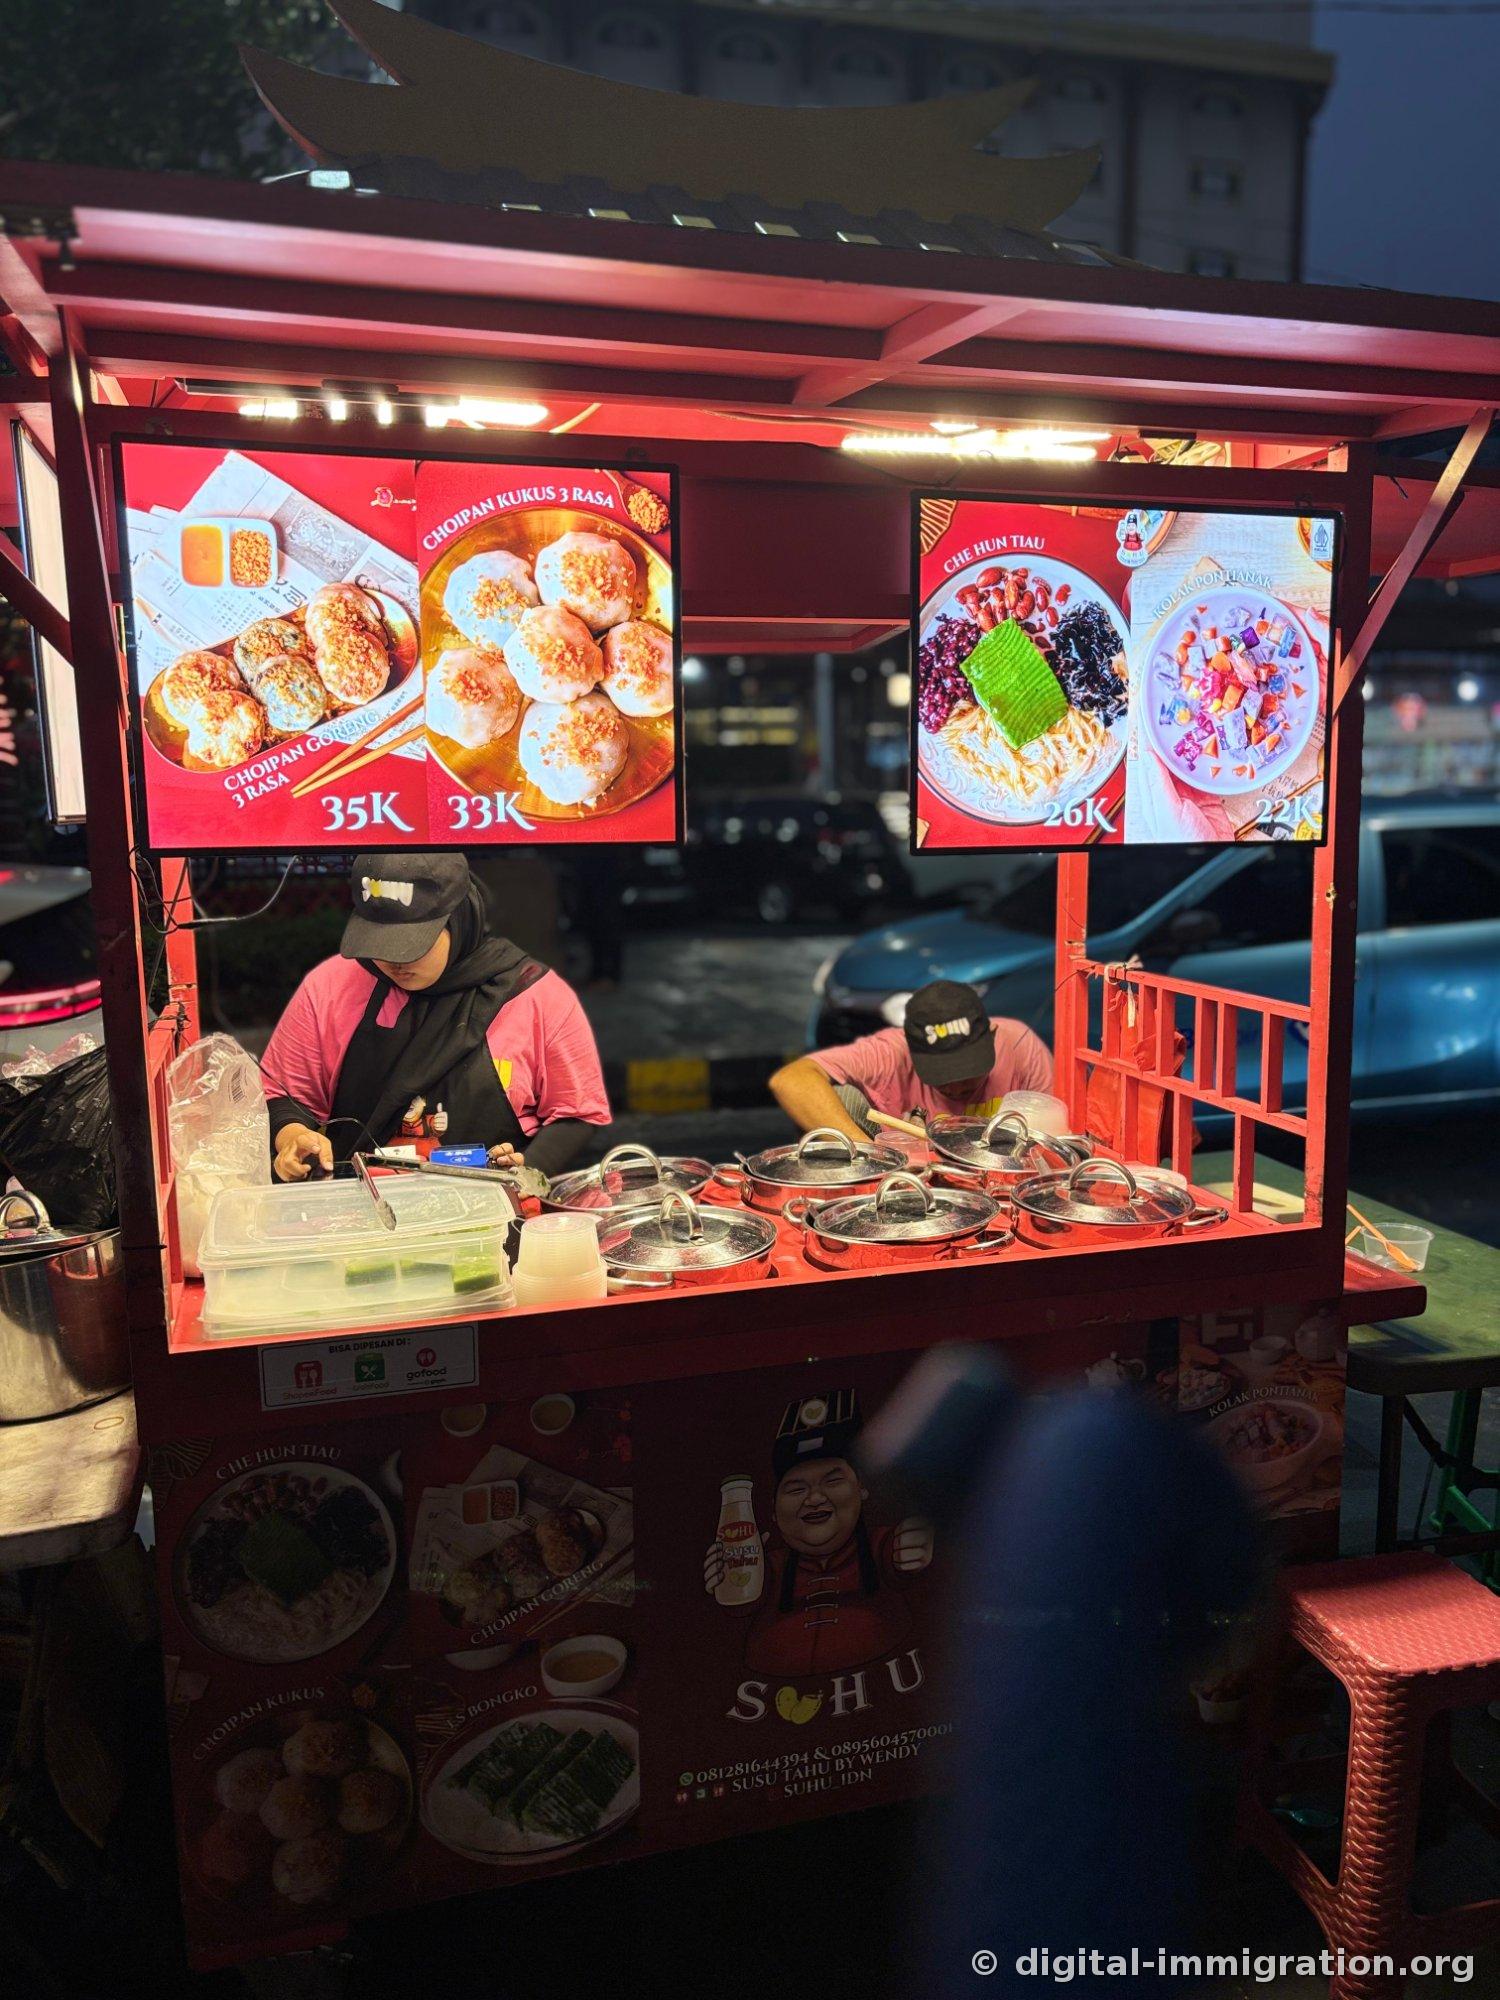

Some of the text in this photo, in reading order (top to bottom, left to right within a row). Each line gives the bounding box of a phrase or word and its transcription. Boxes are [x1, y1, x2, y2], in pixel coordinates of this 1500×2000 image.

[422, 499, 495, 552] CHOIPAN
[497, 486, 555, 509] KUKUS
[559, 487, 569, 502] 3
[572, 487, 615, 509] RASA
[943, 534, 1045, 574] CHE HUN TIAU
[1153, 569, 1272, 619] KOLAK PONTIANAK
[223, 709, 380, 792] CHOIPAN GORENG
[231, 771, 291, 808] 3 RASA
[321, 791, 415, 832] 35K
[447, 791, 537, 831] 33K
[1043, 797, 1116, 832] 26K
[1256, 796, 1321, 829] 22K
[329, 1344, 351, 1354] BISA
[353, 1339, 395, 1351] DIPESAN
[406, 1367, 448, 1381] gofood
[1208, 1391, 1249, 1417] KOLAK
[216, 1444, 341, 1479] CHE HUN TIAU
[470, 1561, 603, 1645] CHOIPAN GORENG
[468, 1685, 538, 1718] BONGKO
[192, 1686, 325, 1761] CHOIPAN KUKUS
[732, 1742, 921, 1793] SUSU TAHU BY WENDY
